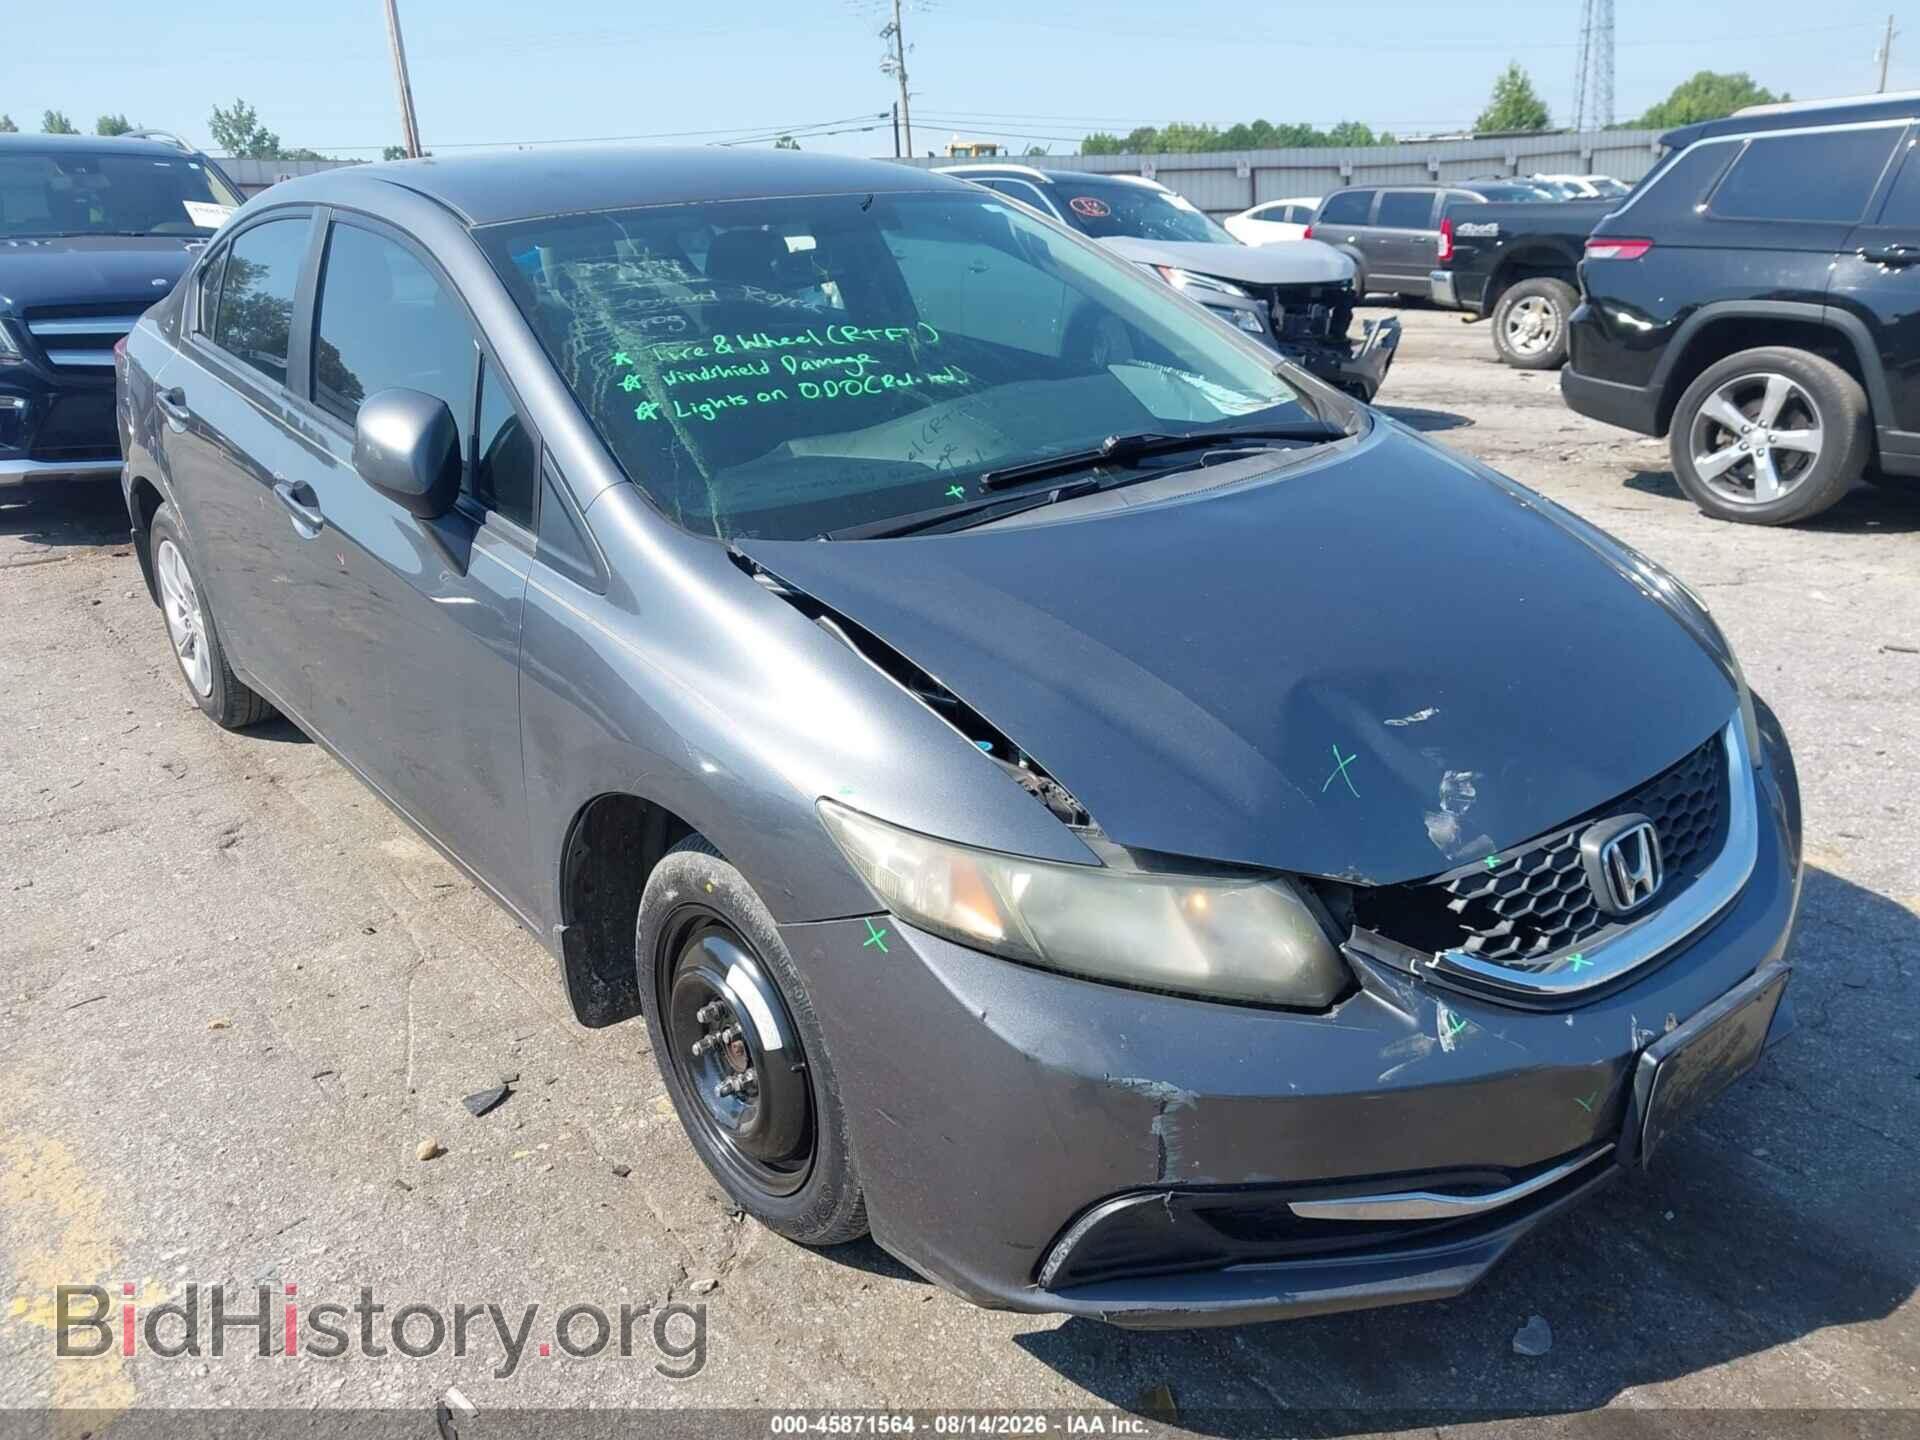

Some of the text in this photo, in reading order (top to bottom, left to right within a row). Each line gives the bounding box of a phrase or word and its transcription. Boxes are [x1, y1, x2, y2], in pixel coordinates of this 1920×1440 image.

[713, 334, 735, 354] &
[736, 329, 823, 350] Wheel
[662, 353, 881, 386] Windshield Damage
[673, 393, 748, 421] Lights
[756, 388, 788, 403] on
